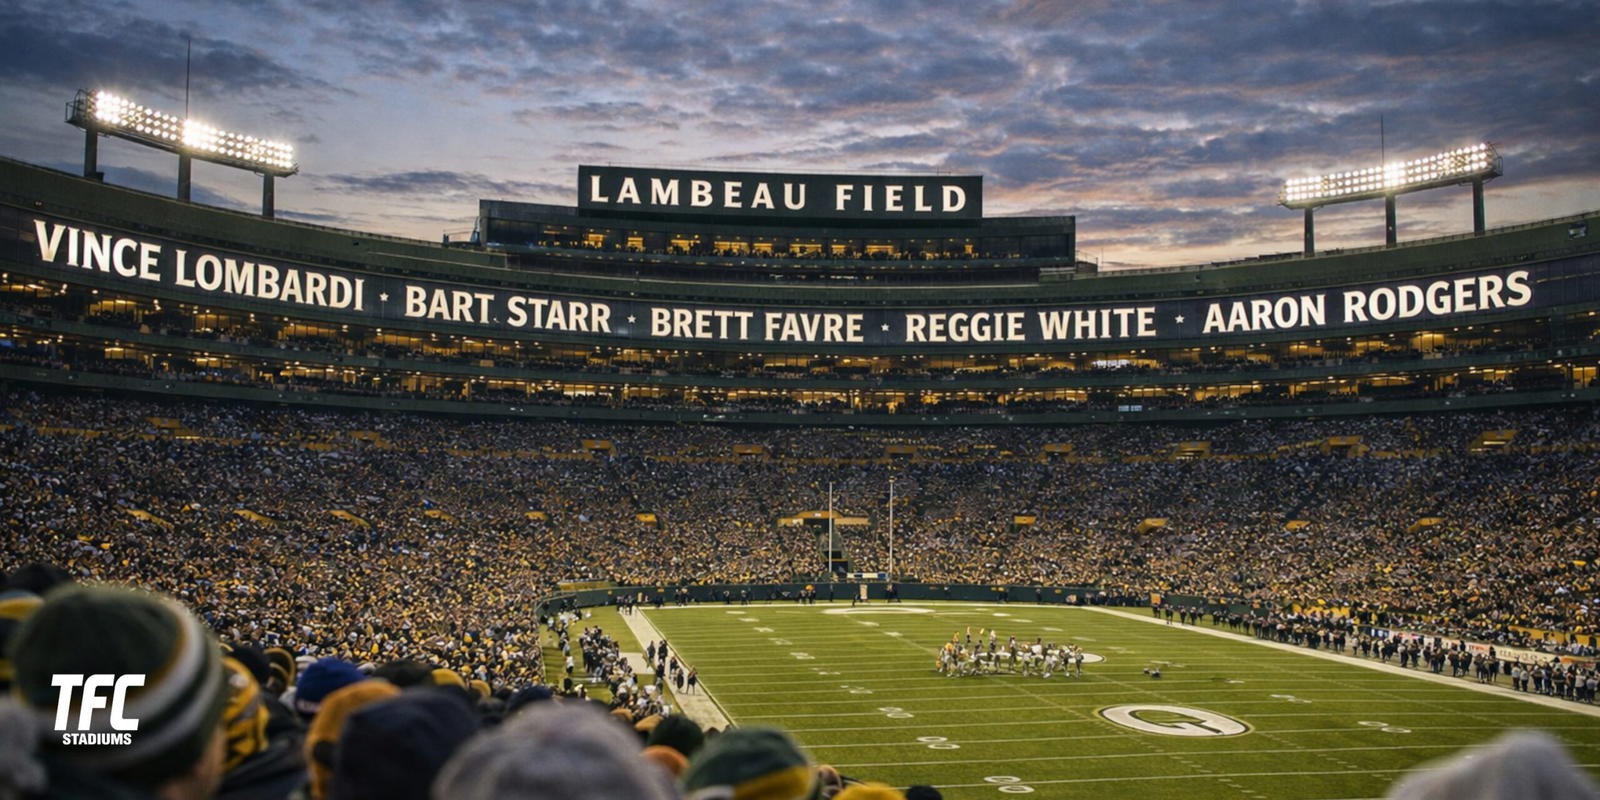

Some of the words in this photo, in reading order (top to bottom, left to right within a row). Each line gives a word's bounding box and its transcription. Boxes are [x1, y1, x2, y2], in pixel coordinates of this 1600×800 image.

[591, 175, 807, 210] LAMBEAU
[836, 183, 967, 213] FIELD
[34, 219, 162, 282] VINCE
[175, 249, 365, 311] LOMBARDI
[405, 285, 494, 325] BART
[507, 296, 612, 333] STARR
[905, 312, 1025, 342] REGGIE
[1038, 306, 1157, 340] WHITE
[1202, 294, 1327, 335] AARON
[1343, 271, 1532, 323] RODGERS
[650, 308, 754, 341] BRETT
[765, 312, 864, 342] FAVRE
